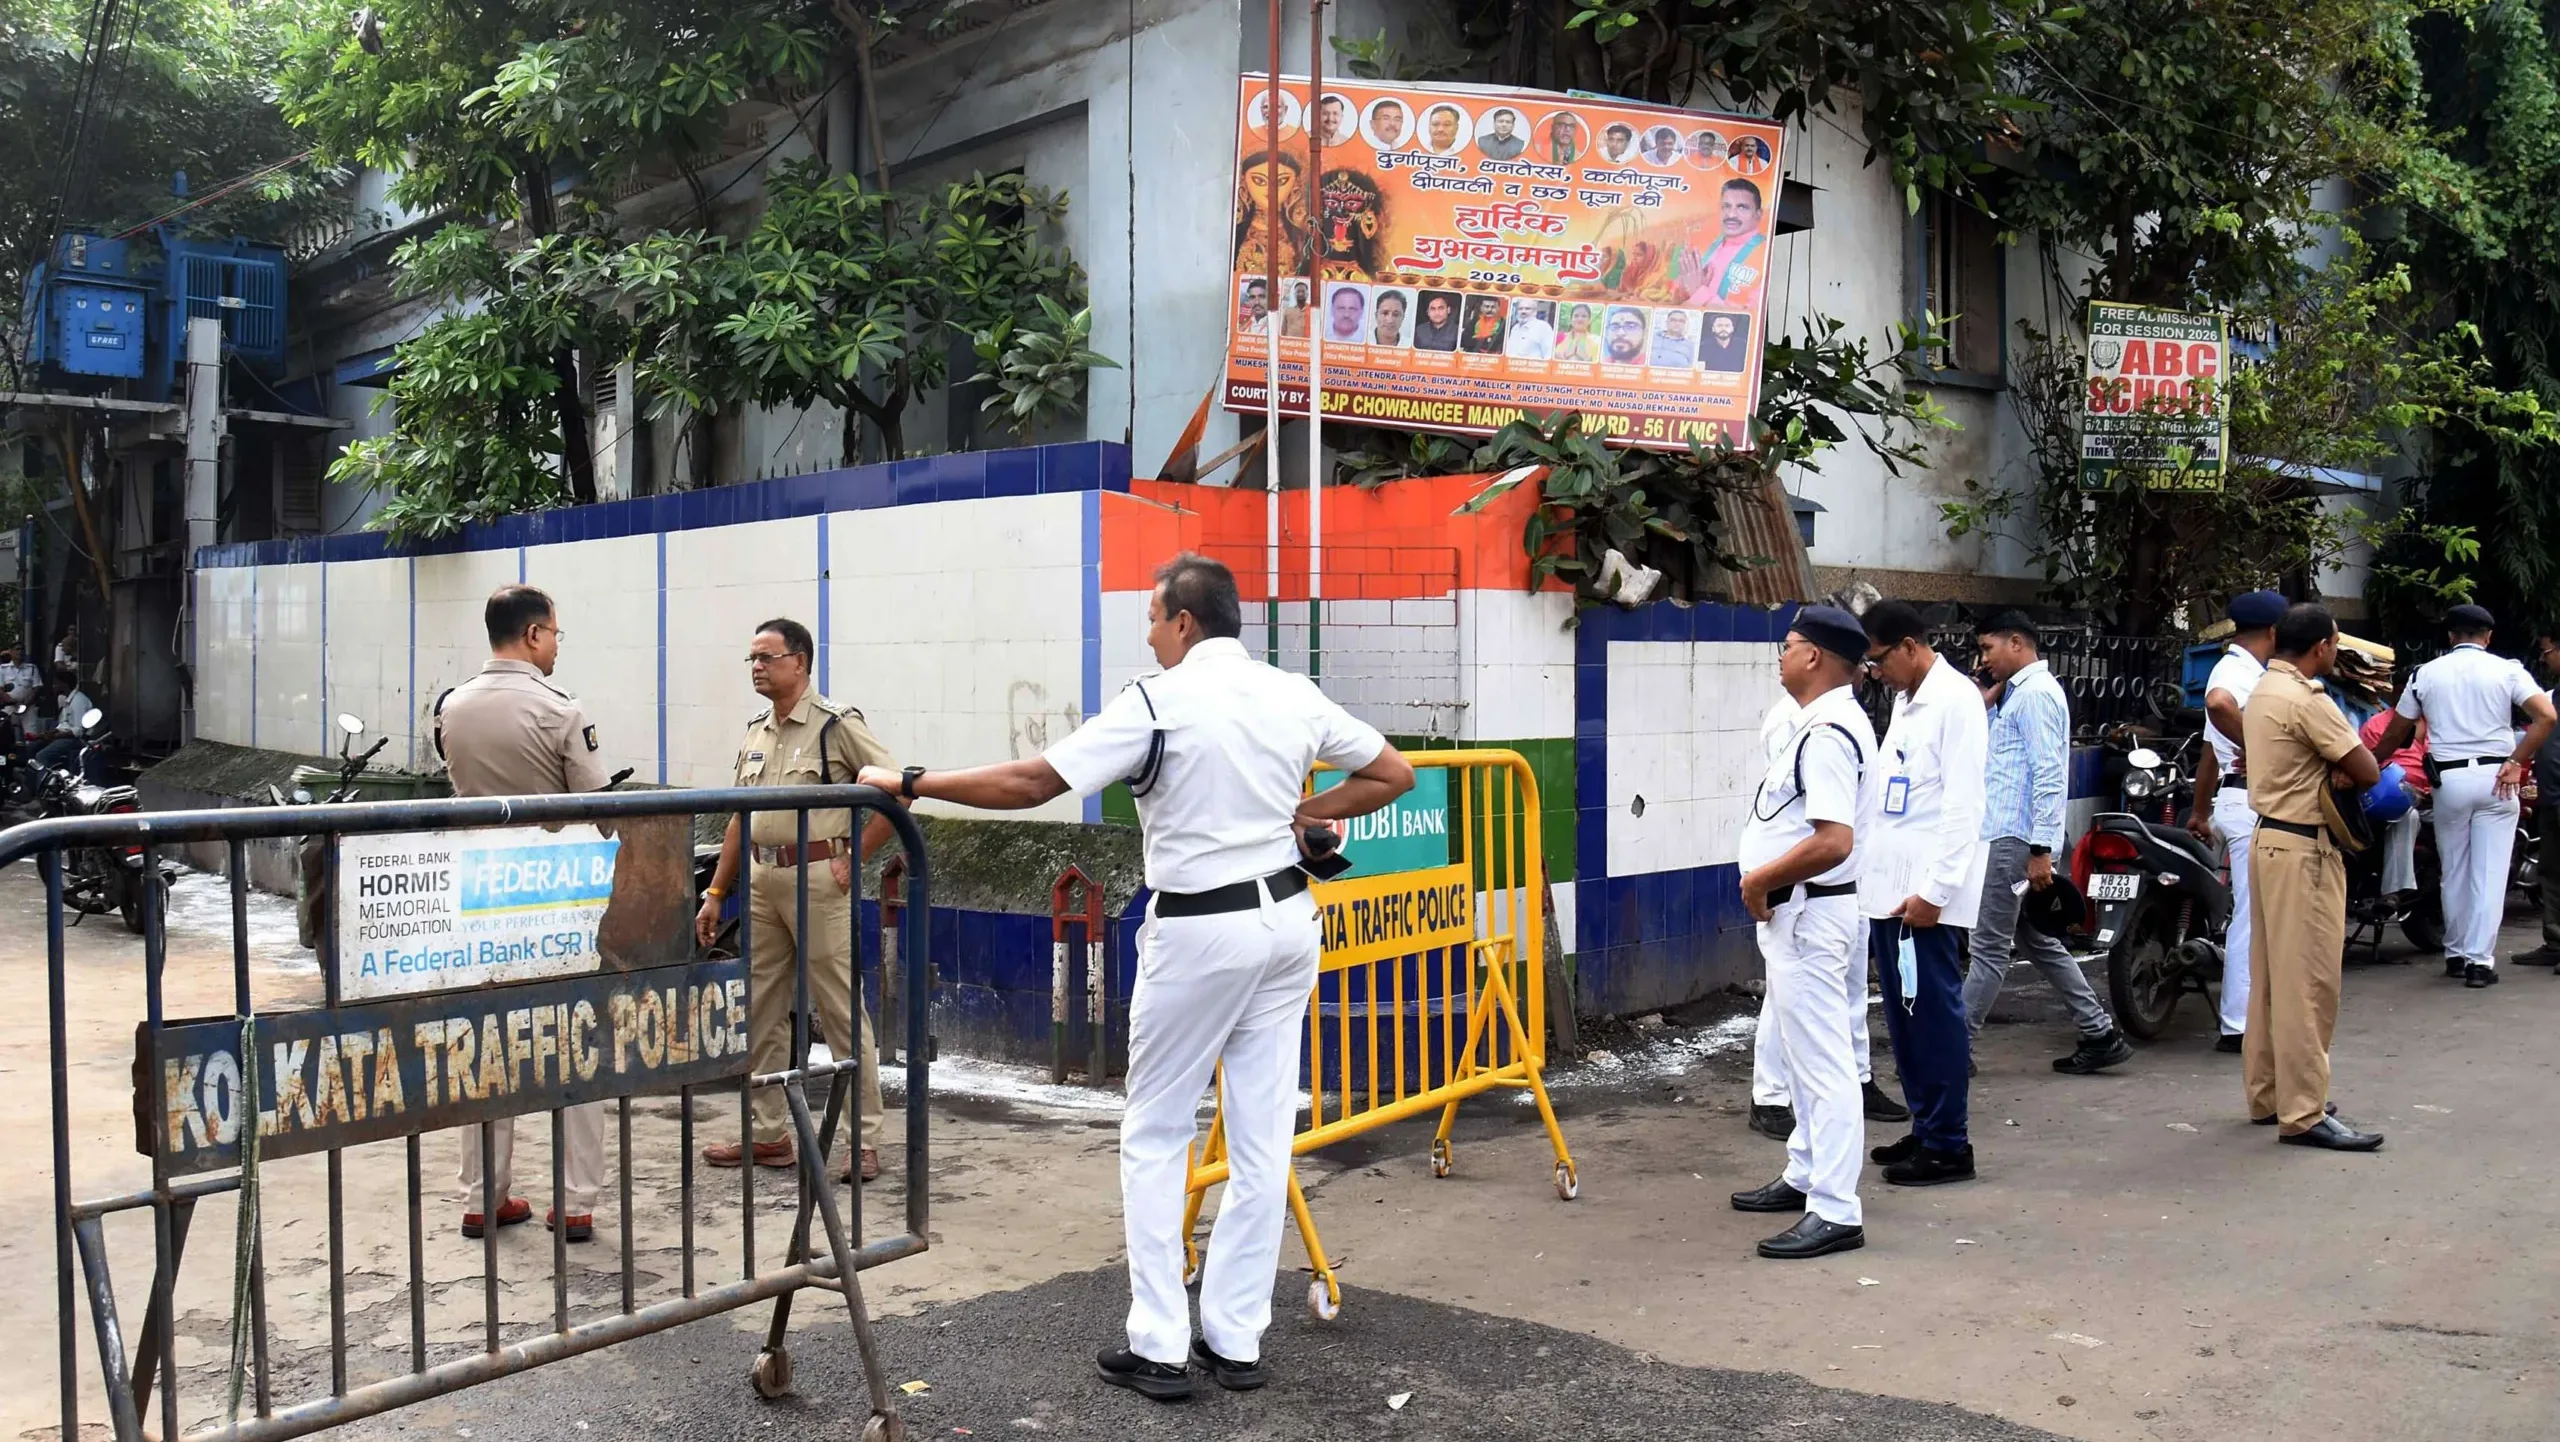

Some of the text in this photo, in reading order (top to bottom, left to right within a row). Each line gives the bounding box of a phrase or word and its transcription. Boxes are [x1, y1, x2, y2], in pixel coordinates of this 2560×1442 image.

[1376, 150, 1690, 191] दुर्गापूजा, धनतेरस, कालीपूजा,
[1412, 172, 1662, 207] दीपावली व छठ पूजा की
[1455, 200, 1567, 239] हार्दिक
[1405, 237, 1601, 277] शुभकामनाएं
[1469, 271, 1521, 284] 2026
[2093, 323, 2218, 341] FOR SESSION 2026
[2100, 308, 2212, 327] FREE ADMISSION
[2120, 340, 2217, 378] ABC
[1235, 359, 1268, 369] MUKESH
[1357, 370, 1396, 381] JITENDRA
[1432, 377, 1471, 387] BISWAJIT
[1517, 383, 1543, 393] PINTU
[1577, 388, 1613, 398] CHOTTU
[1642, 392, 1665, 402] UDAY
[1668, 394, 1704, 404] SANKAR
[1325, 378, 1359, 389] GOUTAM
[1391, 385, 1420, 395] MANOJ
[1452, 390, 1486, 400] SHAYAM
[1517, 395, 1554, 405] JAGDISH
[1679, 406, 1699, 415] RAM
[1231, 385, 1287, 400] COURTSY
[1289, 389, 1305, 404] BY
[1321, 391, 1350, 413] BJP
[1352, 395, 1464, 424] CHOWRANGEE
[1467, 404, 1526, 428] MANDA
[1581, 413, 1631, 435] WARD
[1643, 417, 1664, 438] 56
[1679, 420, 1718, 442] KMC
[2085, 447, 2110, 457] TIME
[1353, 803, 1445, 842] IDBI BANK
[360, 851, 451, 869] FEDERAL BANK
[474, 858, 584, 897] FEDERAL
[360, 869, 451, 898] HORMIS
[2101, 875, 2130, 886] WB 23
[359, 897, 451, 921] MEMORIAL
[1352, 890, 1413, 947] TRAFFIC
[1418, 883, 1466, 935] POLICE
[359, 918, 452, 941] FOUNDATION
[360, 951, 379, 978] A
[385, 941, 473, 976] Federal
[480, 936, 537, 966] Bank
[541, 931, 583, 959] CSR
[415, 1000, 600, 1110] TRAFFIC
[608, 979, 749, 1075] POLICE
